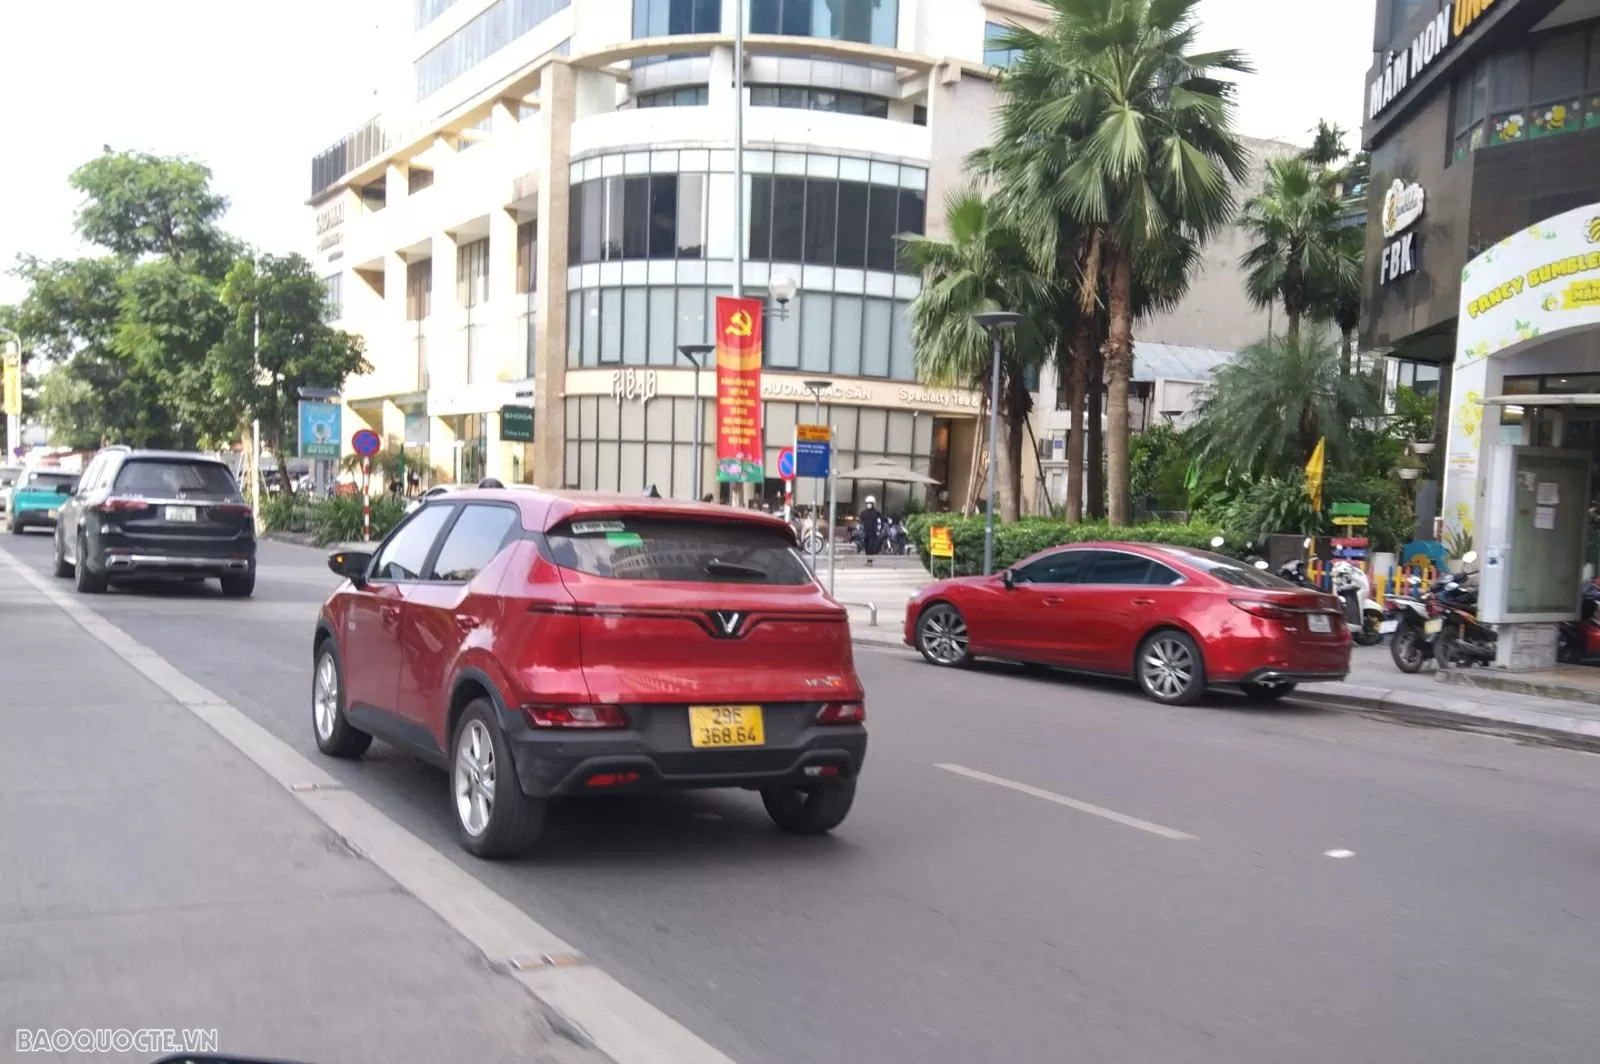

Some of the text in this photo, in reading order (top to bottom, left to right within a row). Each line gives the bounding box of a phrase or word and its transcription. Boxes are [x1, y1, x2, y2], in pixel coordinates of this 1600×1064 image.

[1411, 3, 1450, 79] NON
[1380, 232, 1413, 286] FBK
[1467, 276, 1524, 319] FANCY
[899, 388, 949, 405] Specialty
[711, 707, 743, 724] 29E
[701, 727, 757, 745] 368.64
